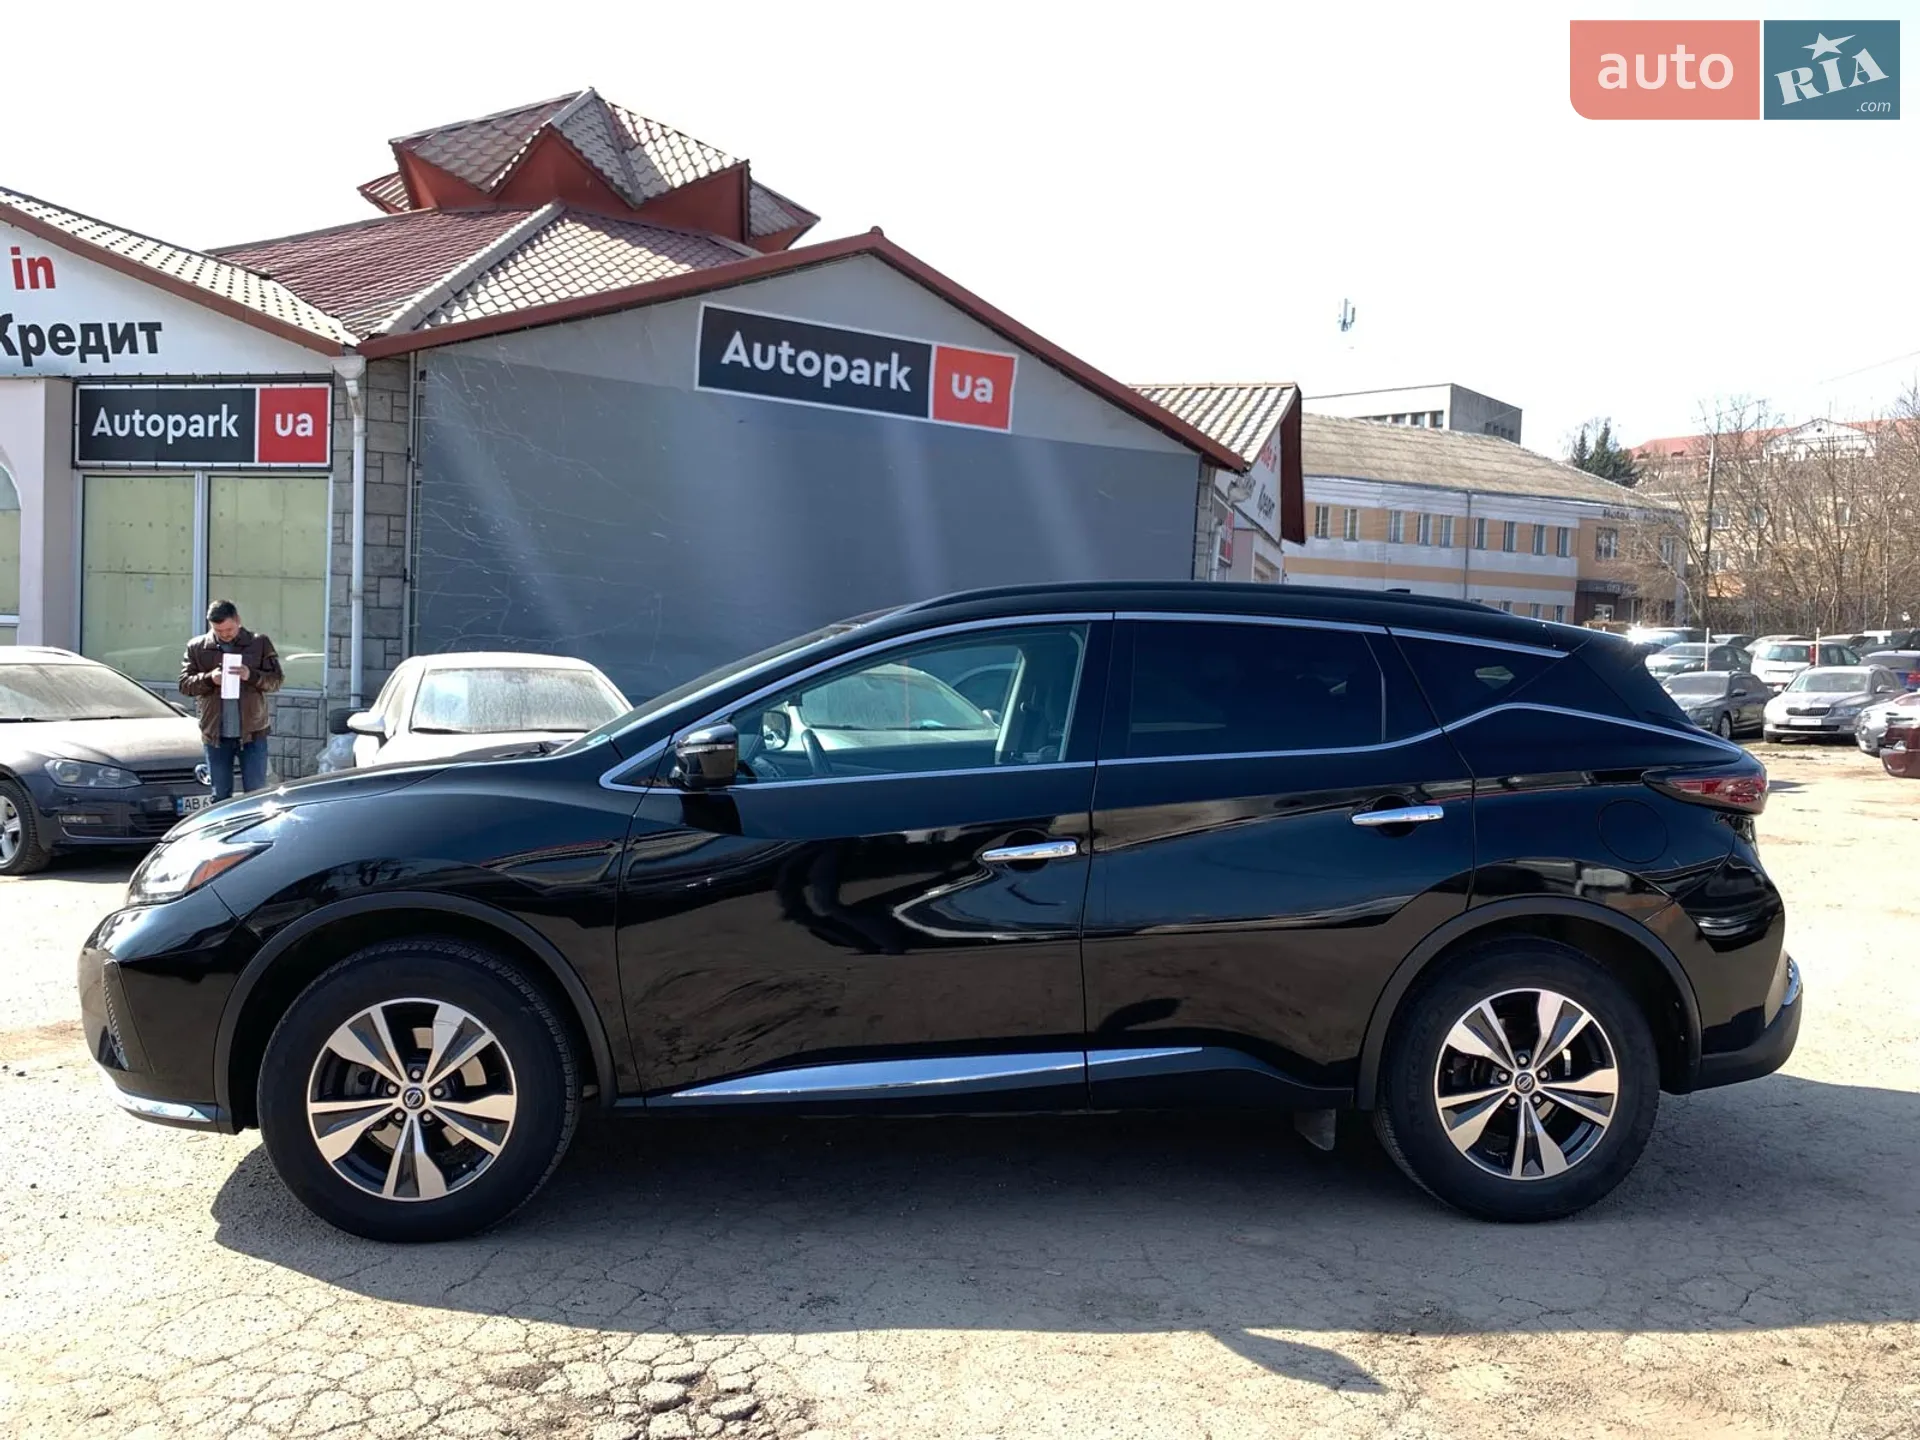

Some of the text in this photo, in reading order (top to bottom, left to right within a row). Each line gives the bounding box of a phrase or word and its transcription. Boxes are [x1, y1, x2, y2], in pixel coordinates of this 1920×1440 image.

[11, 247, 56, 289] in
[721, 330, 994, 404] Autopark ua
[92, 404, 314, 445] Autopark ua
